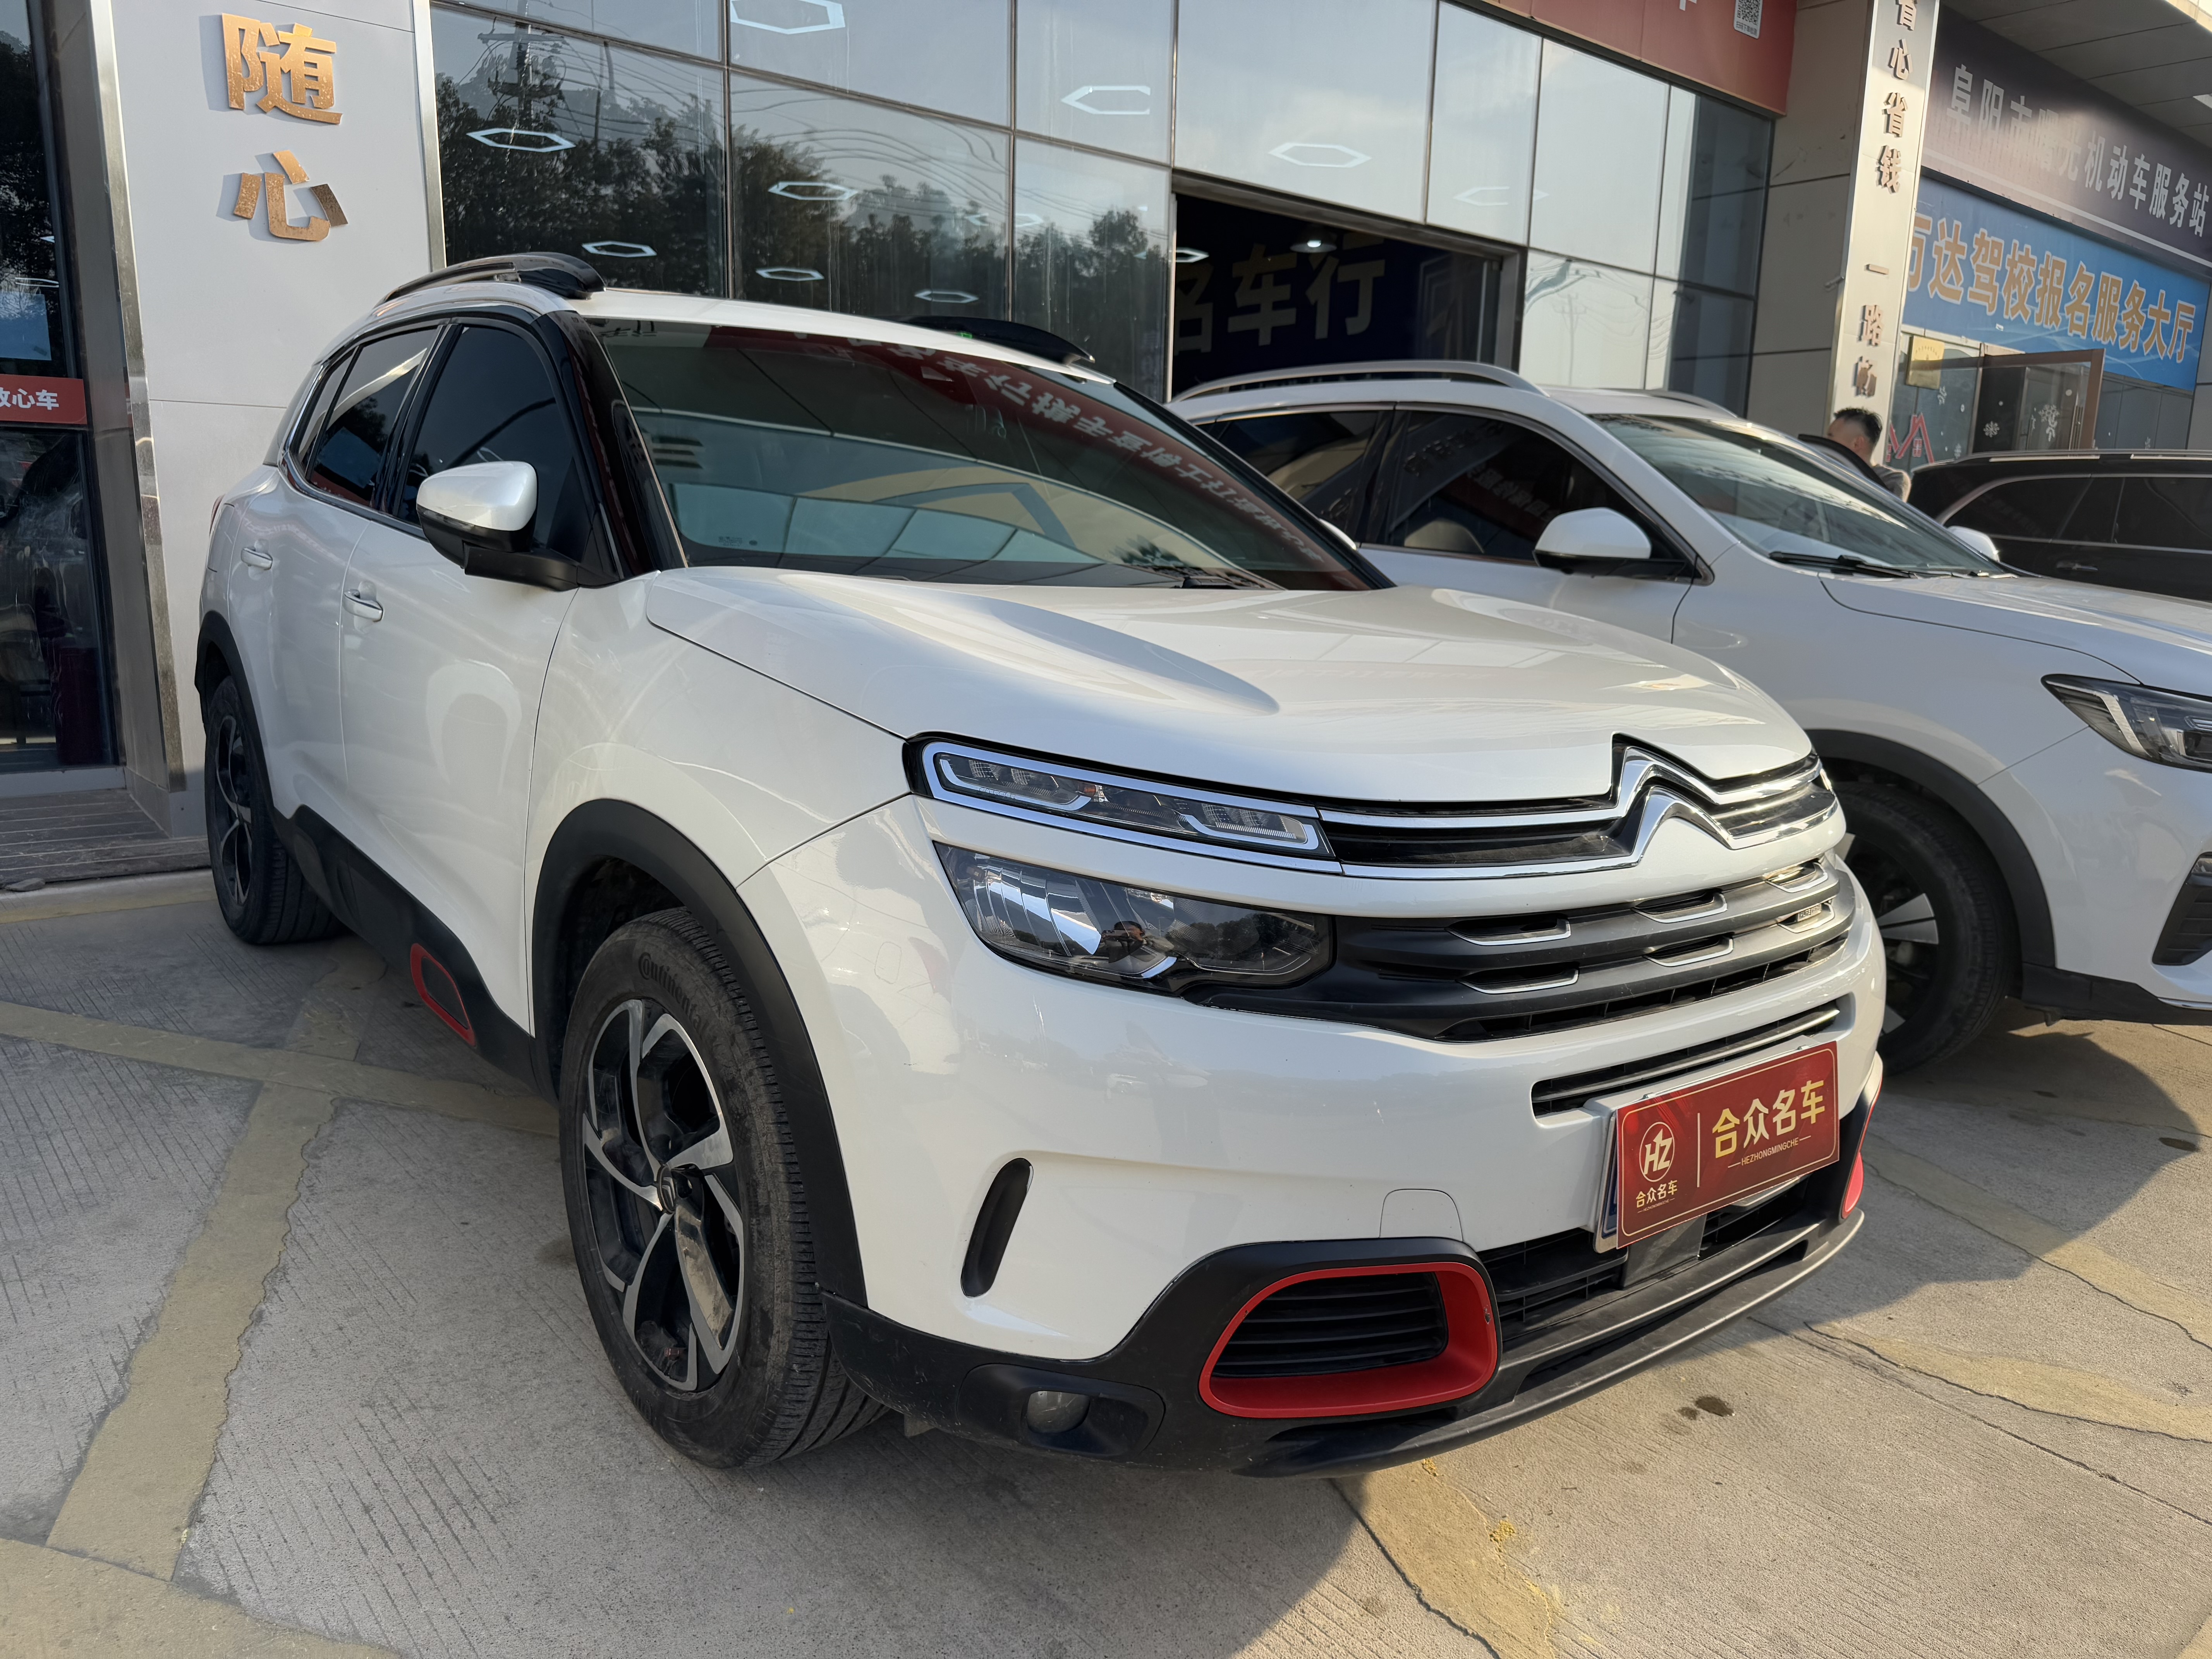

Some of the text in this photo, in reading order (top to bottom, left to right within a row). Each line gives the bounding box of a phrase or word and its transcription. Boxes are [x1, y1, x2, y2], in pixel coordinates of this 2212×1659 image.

[222, 13, 348, 242] 随心
[638, 951, 709, 1038] Continental
[1712, 1079, 1826, 1158] 合众名车
[1643, 1128, 1674, 1176] HZ
[1741, 1138, 1799, 1166] HEZHONGMINGCHE
[1636, 1180, 1678, 1208] 合众名车
